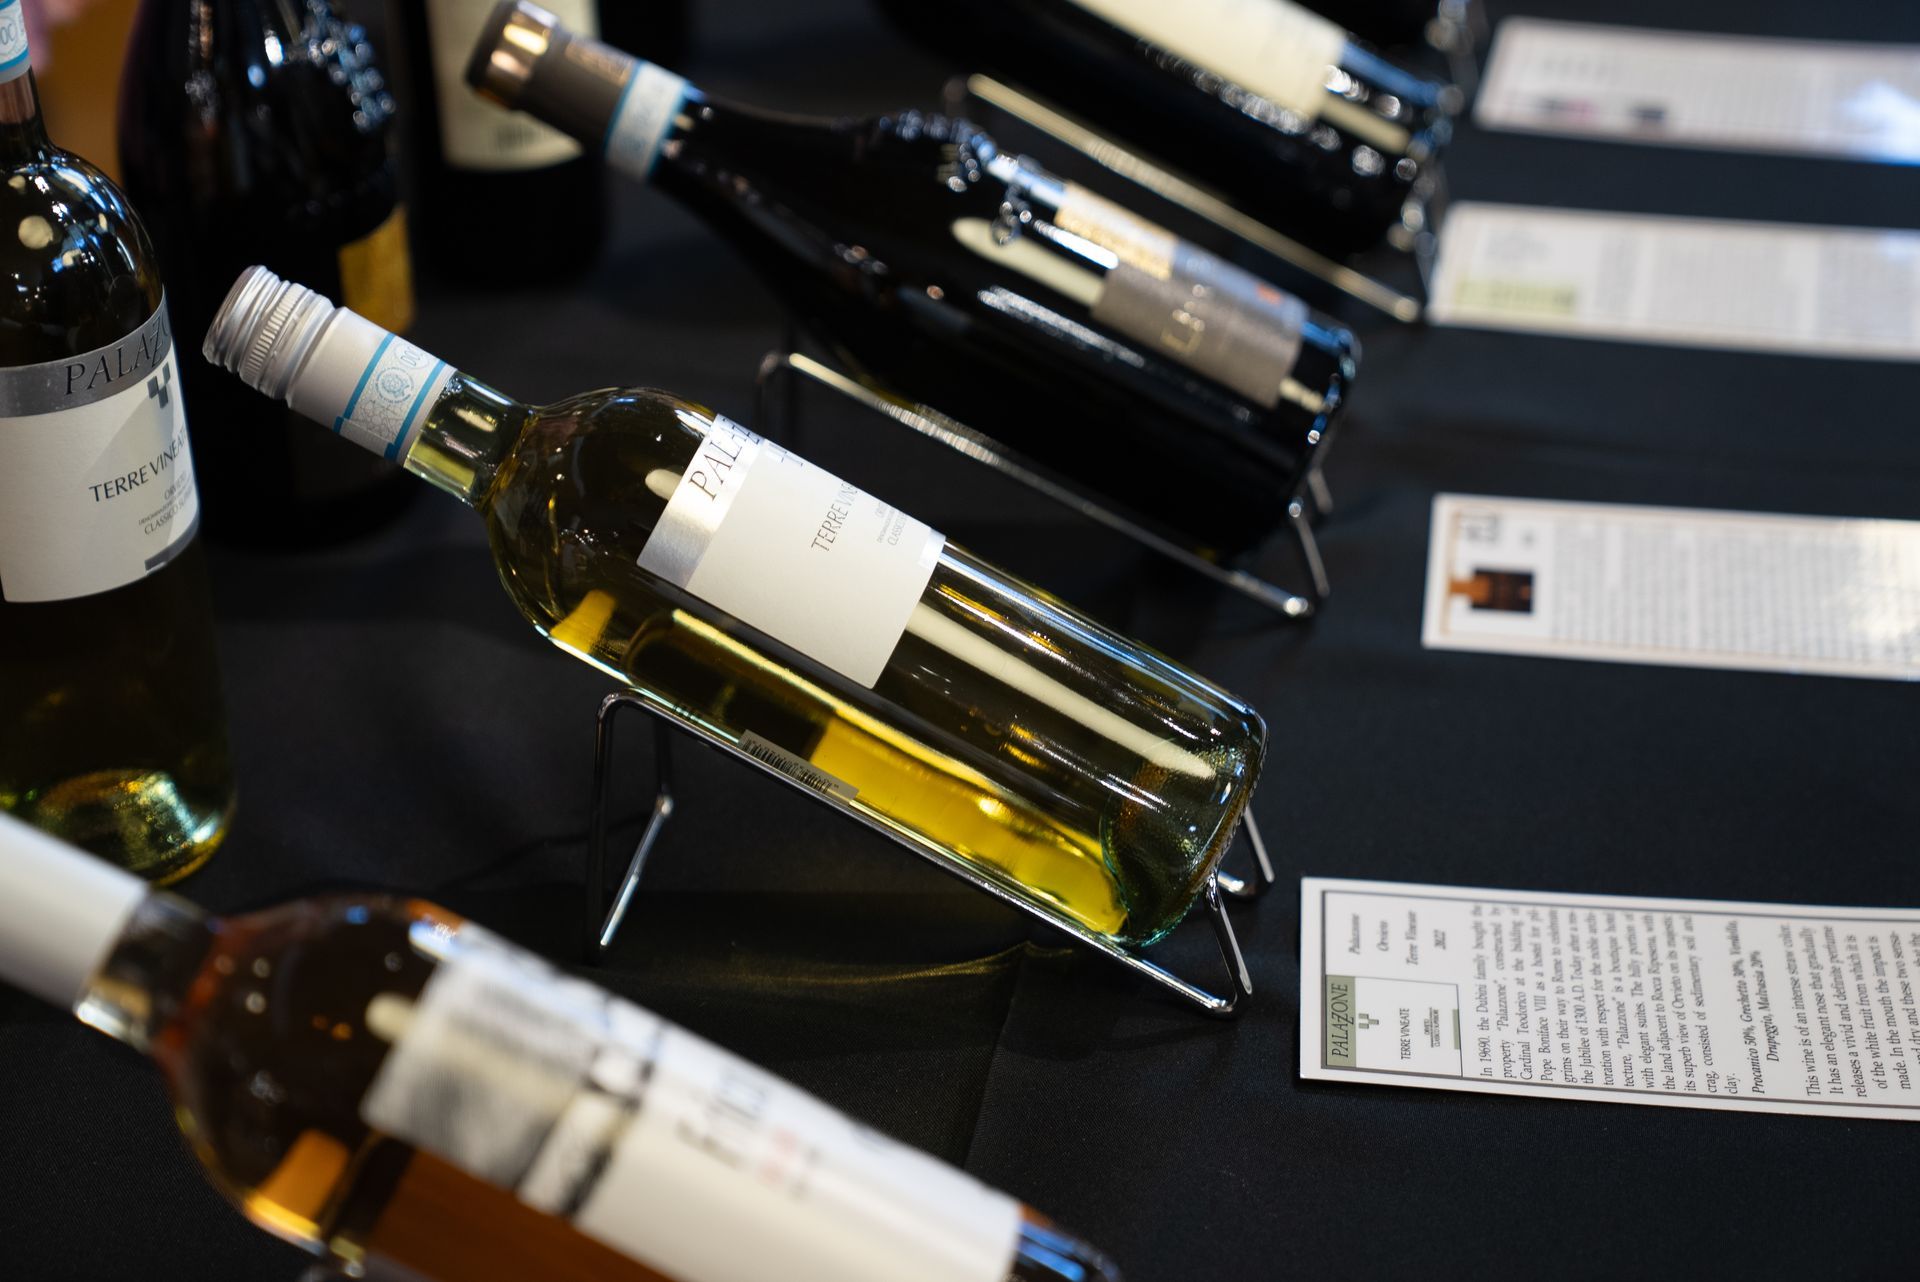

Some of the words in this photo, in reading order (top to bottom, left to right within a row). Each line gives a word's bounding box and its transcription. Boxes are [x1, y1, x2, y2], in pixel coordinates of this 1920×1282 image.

[89, 464, 149, 504] TERRE
[811, 503, 849, 552] TERRE
[1490, 923, 1505, 970] constructed
[1510, 920, 1524, 952] bidding
[1568, 934, 1580, 953] after
[1626, 925, 1643, 955] portion
[1682, 937, 1696, 950] soil
[1823, 926, 1844, 964] perfume
[1530, 943, 1543, 967] hostel
[1552, 947, 1561, 956] to
[1587, 937, 1600, 959] noble
[1609, 937, 1622, 973] boutique
[1667, 950, 1678, 960] its
[1799, 928, 1824, 970] gradually
[1473, 954, 1488, 980] family
[1512, 958, 1524, 971] the
[1551, 959, 1564, 983] Rome
[1569, 955, 1584, 981] Today
[1589, 963, 1602, 975] the
[1670, 963, 1680, 974] on
[1786, 951, 1798, 975] straw
[1847, 953, 1864, 981] which
[1869, 945, 1888, 977] impact
[1896, 961, 1908, 979] two
[1515, 977, 1525, 986] at
[1536, 981, 1545, 991] as
[1555, 986, 1565, 994] to
[1591, 978, 1604, 991] for
[1630, 981, 1644, 997] The
[1651, 977, 1664, 1001] Rocca
[1689, 955, 1704, 1007] sedimentary
[1809, 972, 1823, 990] that
[1830, 966, 1847, 1001] definite
[1876, 979, 1889, 993] the
[1475, 984, 1488, 1013] Dubini
[1533, 995, 1546, 1012] VIII
[1571, 984, 1585, 1003] A.D.
[1671, 976, 1684, 1009] Orvieto
[1737, 980, 1753, 1022] Grechetto
[1790, 976, 1805, 1010] intense
[1815, 992, 1828, 1014] nose
[1856, 984, 1870, 1006] from
[1900, 981, 1914, 1005] these
[1515, 992, 1529, 1034] Teodorico
[1557, 999, 1570, 1016] way
[1574, 1005, 1587, 1024] 1300
[1594, 994, 1610, 1024] respect
[1634, 1002, 1648, 1028] suites.
[1655, 1003, 1665, 1012] to
[1672, 1011, 1686, 1020] of
[1693, 1011, 1706, 1020] of
[1796, 1012, 1808, 1024] an
[1834, 1004, 1851, 1022] and
[1859, 1008, 1875, 1029] fruit
[1878, 996, 1897, 1027] mouth
[1902, 1008, 1919, 1026] and
[1399, 1007, 1410, 1038] VINEATE
[1477, 1017, 1490, 1031] the
[1556, 1019, 1569, 1039] their
[1575, 1026, 1589, 1036] of
[1656, 1015, 1673, 1051] adjacent
[1676, 1023, 1689, 1044] view
[1795, 1026, 1810, 1036] of
[1817, 1016, 1837, 1051] elegant
[1536, 1017, 1551, 1053] Boniface
[1596, 1027, 1609, 1047] with
[1695, 1025, 1713, 1066] consisted
[1743, 1025, 1757, 1046] 50%,
[1761, 1014, 1780, 1062] Drupeggio,
[1838, 1024, 1856, 1049] vivid
[1865, 1032, 1881, 1059] white
[1886, 1029, 1901, 1044] the
[1400, 1038, 1411, 1060] TERRE
[1478, 1036, 1491, 1062] 19690.
[1561, 1043, 1571, 1054] on
[1577, 1037, 1595, 1068] Jubilee
[1638, 1032, 1655, 1064] elegant
[1890, 1047, 1904, 1057] In
[1500, 1040, 1517, 1079] property
[1517, 1041, 1533, 1080] Cardinal
[1540, 1059, 1556, 1081] Pope
[1560, 1057, 1577, 1083] grims
[1600, 1050, 1614, 1085] toration
[1622, 1054, 1634, 1087] tecture,
[1658, 1053, 1673, 1073] land
[1678, 1046, 1697, 1078] superb
[1802, 1049, 1816, 1072] wine
[1826, 1054, 1838, 1066] an
[1870, 1061, 1885, 1076] the
[1480, 1067, 1493, 1077] In
[1580, 1070, 1594, 1084] the
[1640, 1068, 1654, 1088] with
[1706, 1071, 1720, 1092] crag,
[1747, 1048, 1765, 1094] Procanico
[1827, 1068, 1842, 1085] has
[1850, 1059, 1867, 1097] releases
[1893, 1060, 1911, 1089] made.
[1662, 1075, 1676, 1090] the
[1684, 1080, 1696, 1091] its
[1724, 1073, 1741, 1094] clay.
[1805, 1075, 1821, 1095] This
[1872, 1079, 1888, 1089] of
